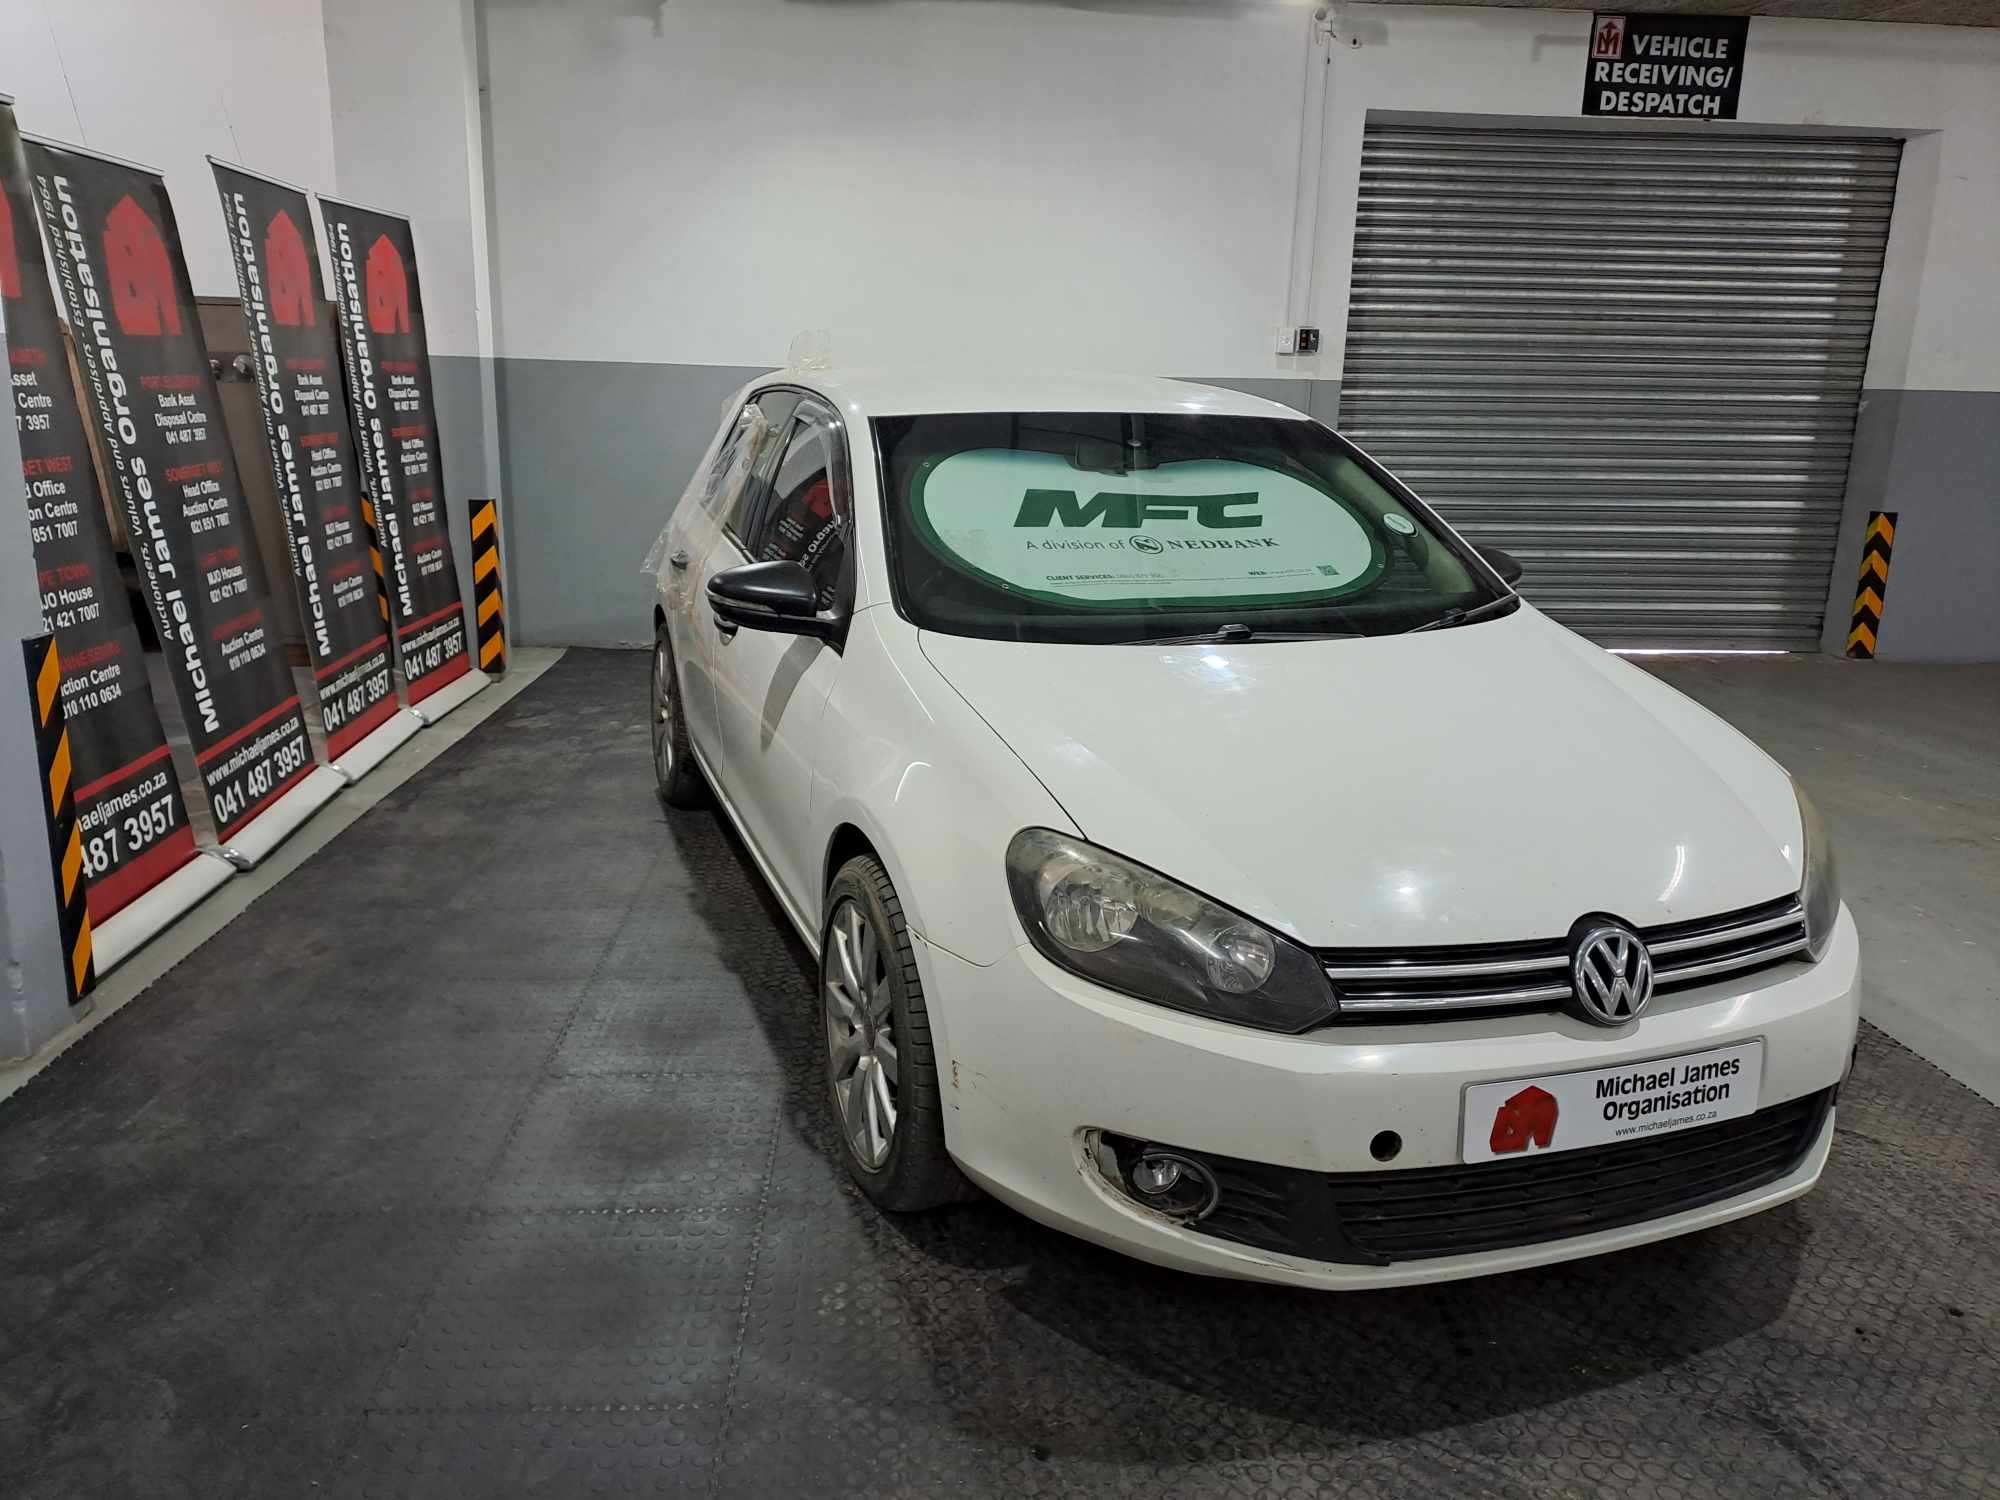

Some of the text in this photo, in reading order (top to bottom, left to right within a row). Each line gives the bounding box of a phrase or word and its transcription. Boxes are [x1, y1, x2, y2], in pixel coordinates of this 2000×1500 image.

[1632, 34, 1729, 59] VEHICLE
[1594, 61, 1735, 89] RECEIVING/
[1600, 90, 1722, 116] DESPATCH
[36, 175, 57, 219] 1964
[48, 224, 85, 328] Established
[18, 392, 52, 409] Centre
[83, 343, 117, 435] Appraisers
[27, 414, 50, 431] 3957
[233, 192, 331, 657] Michael James Organisation
[337, 222, 413, 617] Michael James Organisation
[353, 403, 366, 428] and
[54, 175, 220, 734] Michael James Organisation
[107, 438, 126, 471] and
[33, 479, 66, 498] Office
[120, 474, 144, 537] Valuers
[44, 501, 79, 518] Centre
[1013, 488, 1264, 529] MFC
[32, 520, 78, 543] 851 7007
[1026, 537, 1281, 551] A division of NEDBANK
[41, 586, 94, 611] JO House
[141, 542, 174, 641] Auctioneers,
[42, 602, 100, 632] 21 421 7007
[404, 631, 463, 681] 041 487 3957
[90, 663, 121, 685] Centre
[80, 692, 98, 713] 110
[99, 682, 122, 704] 0634
[323, 669, 390, 732] 041 487 3957
[206, 717, 300, 787] www.michaeljames.co.za
[213, 735, 306, 823] 041 487 3957
[123, 794, 176, 851] 3957
[1595, 1058, 1741, 1099] Michael James
[1603, 1083, 1731, 1121] Organisation
[1615, 1110, 1718, 1137] www.michaeljames.co.za
